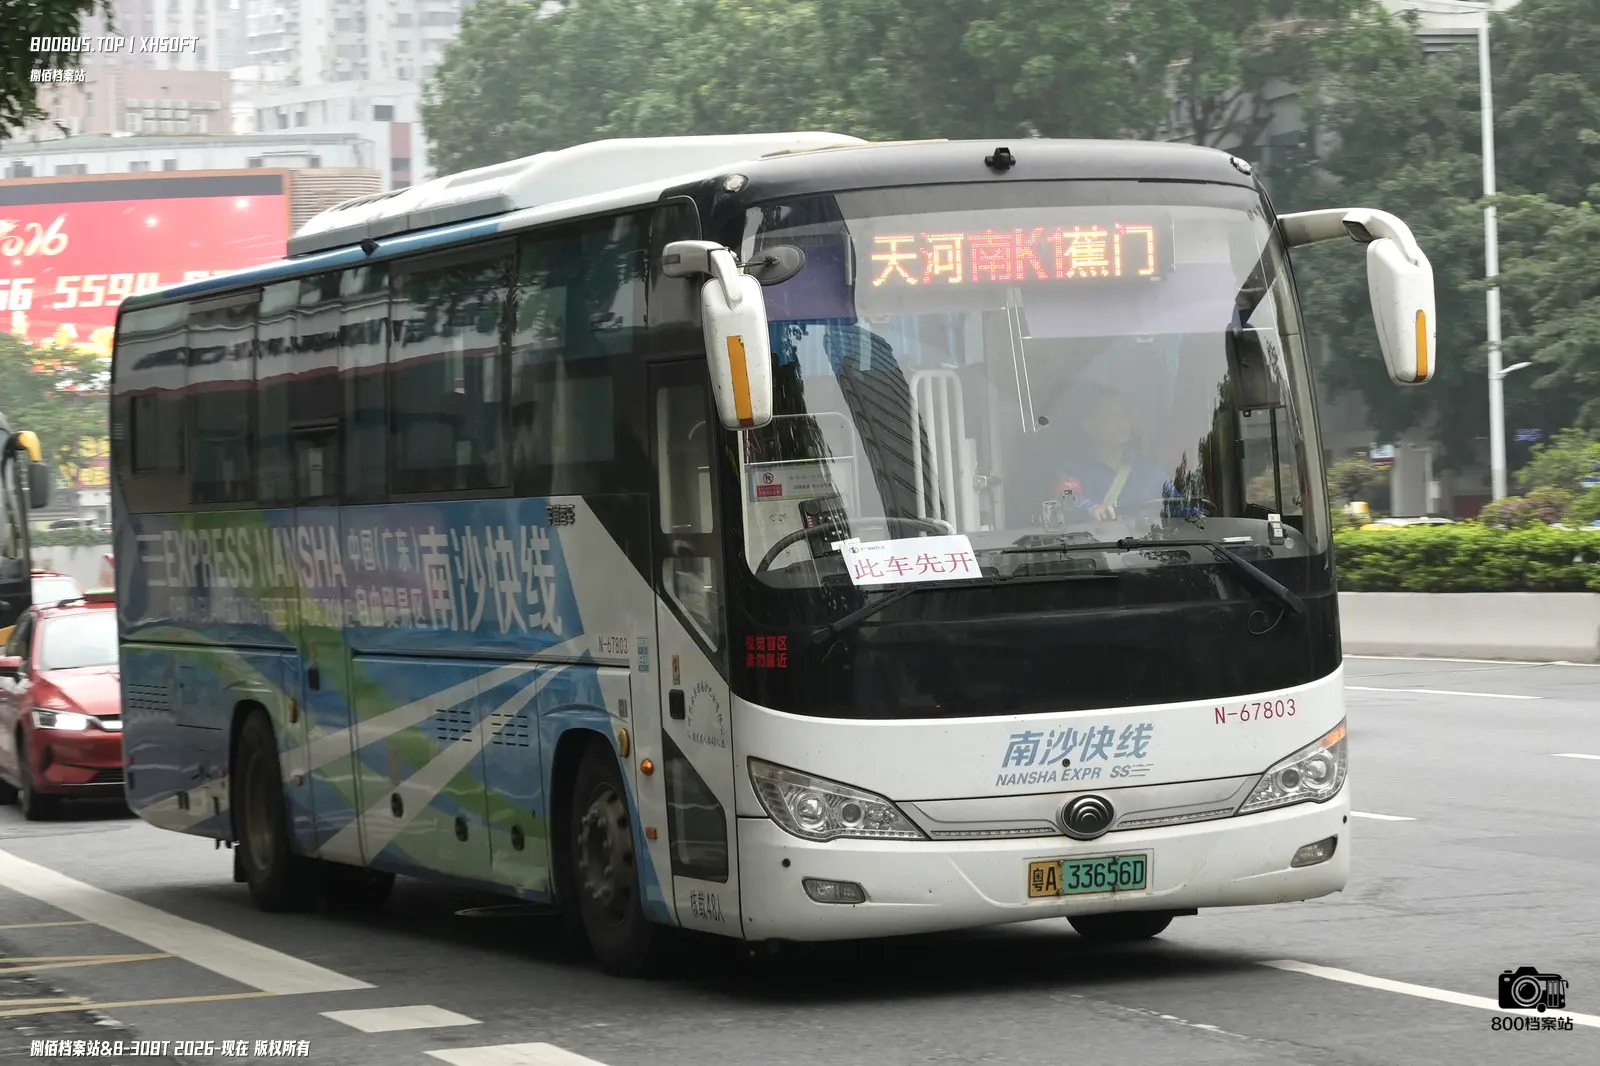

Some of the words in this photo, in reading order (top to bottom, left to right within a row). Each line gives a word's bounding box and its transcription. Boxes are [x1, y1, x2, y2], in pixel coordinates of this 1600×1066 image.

[162, 528, 254, 588] EXPRESS
[255, 525, 348, 588] NANSHA
[854, 551, 974, 580] 此车先开
[418, 525, 563, 636] 南沙快线
[598, 636, 628, 655] N-67803
[1214, 698, 1297, 725] N-67803
[1001, 723, 1155, 768] 南沙快线
[995, 770, 1057, 787] NANSHA
